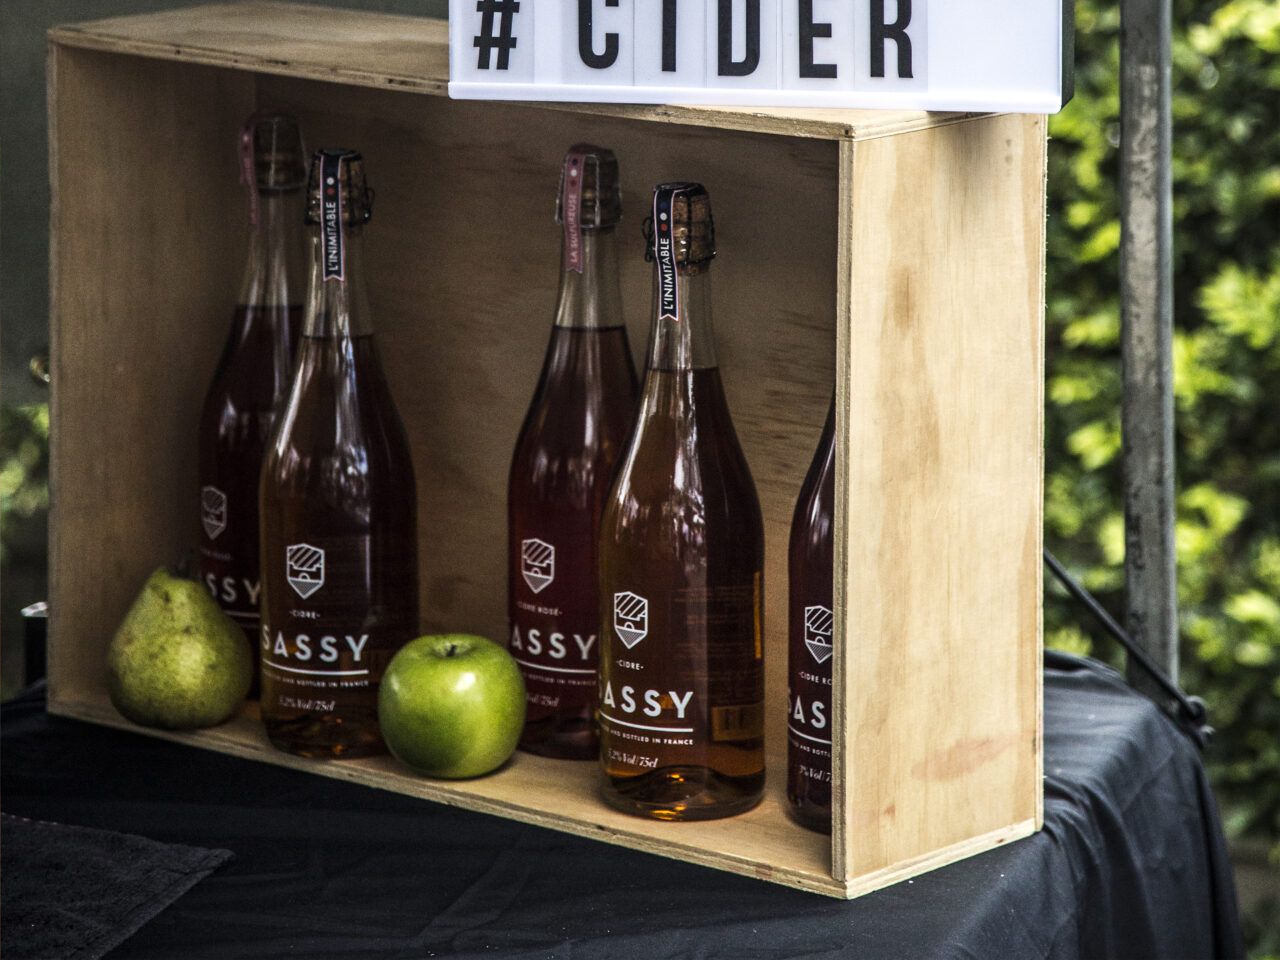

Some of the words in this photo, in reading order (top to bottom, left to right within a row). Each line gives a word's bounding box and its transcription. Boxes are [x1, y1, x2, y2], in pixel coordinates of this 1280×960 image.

[325, 201, 340, 272] L'INIMITABLE
[660, 237, 675, 311] L'INIMITABLE
[262, 623, 370, 663] SASSY
[599, 680, 695, 720] ASSY
[663, 738, 695, 747] FRANCE
